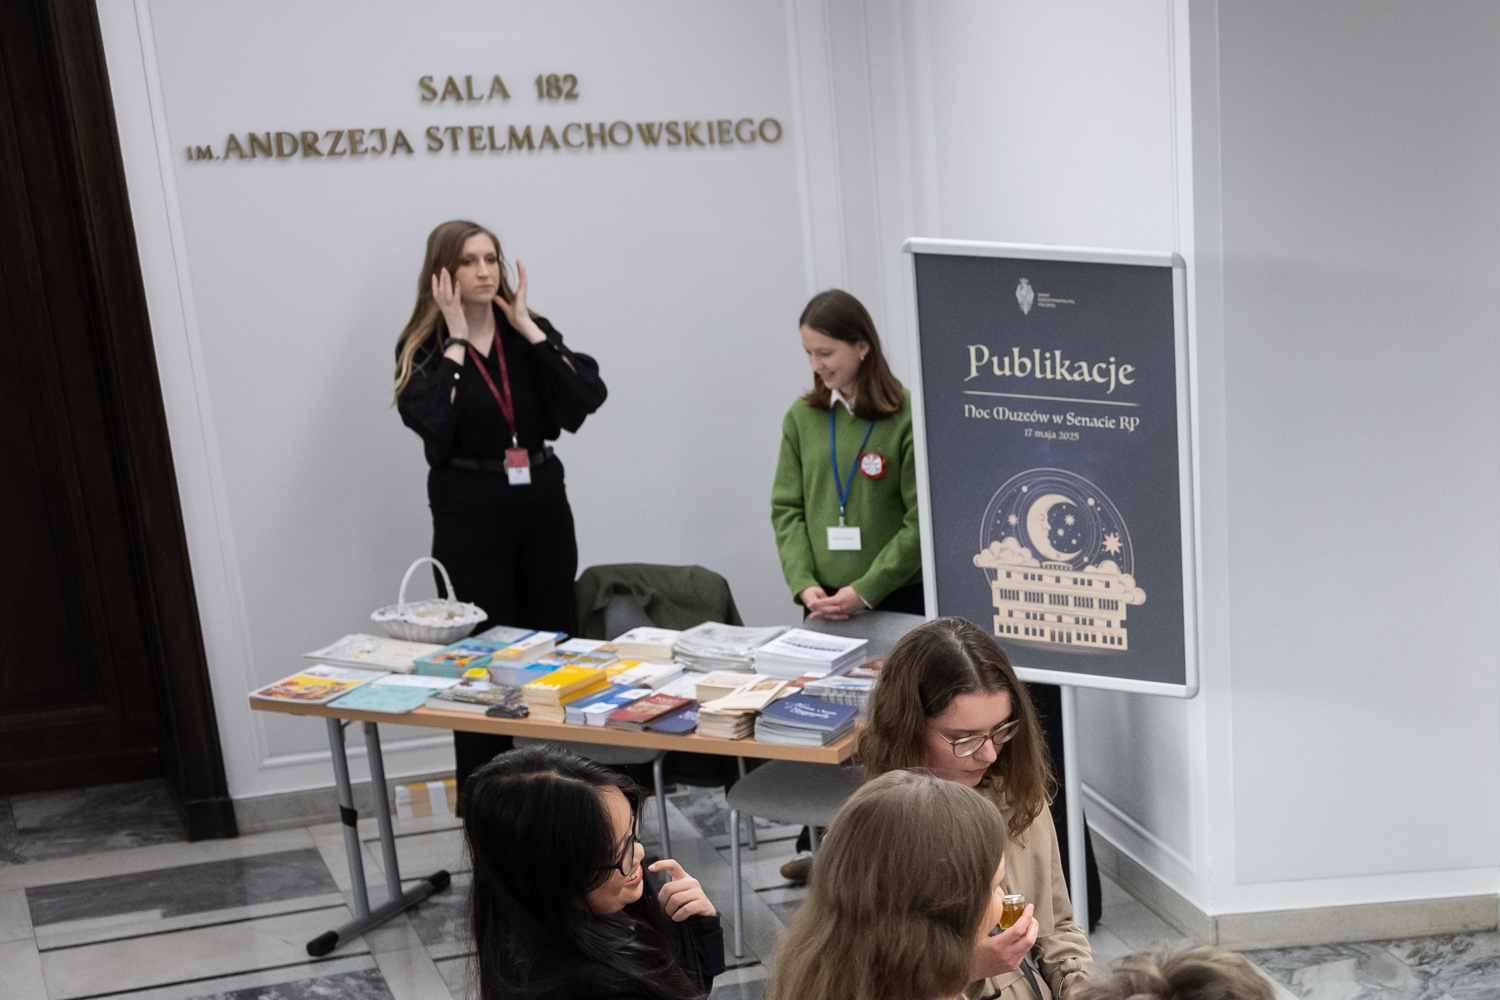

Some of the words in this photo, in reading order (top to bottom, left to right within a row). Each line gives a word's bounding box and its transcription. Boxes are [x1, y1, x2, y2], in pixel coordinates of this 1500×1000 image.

[418, 74, 511, 103] SALA
[535, 74, 580, 101] 182
[222, 127, 416, 161] ANDRZEJA
[425, 116, 784, 154] STELMACHOWSKIEGO
[964, 344, 1136, 395] Publikacje
[964, 404, 991, 420] Noc
[993, 406, 1050, 423] Muzeów
[1052, 414, 1064, 425] w
[1066, 412, 1117, 429] Senacie
[1119, 416, 1140, 433] RP
[1024, 428, 1033, 438] 17
[1035, 430, 1057, 440] maja
[1058, 431, 1080, 441] 2025
